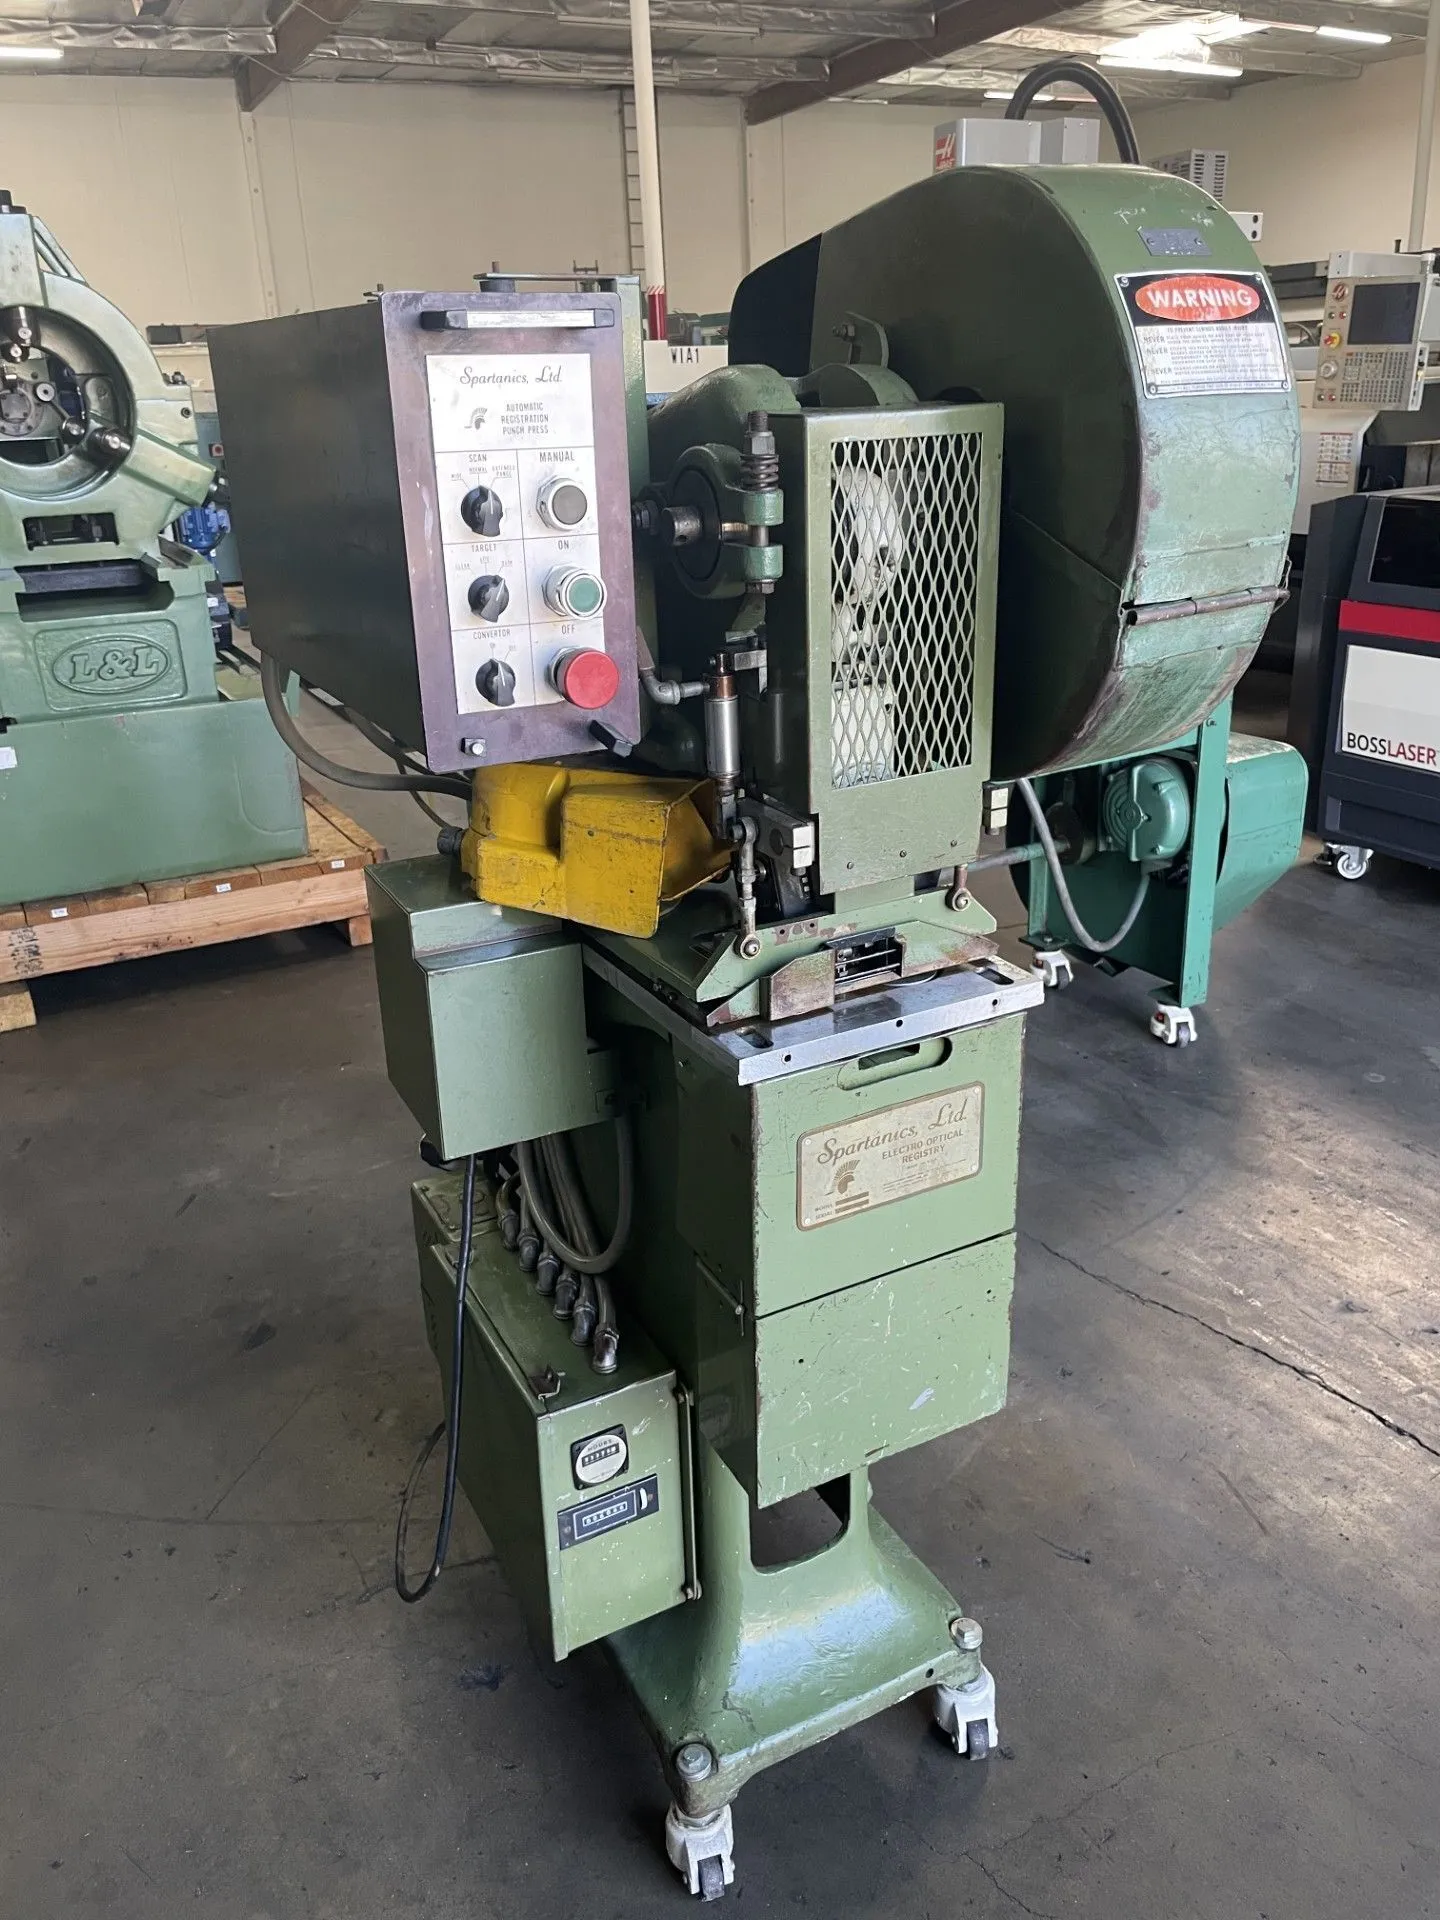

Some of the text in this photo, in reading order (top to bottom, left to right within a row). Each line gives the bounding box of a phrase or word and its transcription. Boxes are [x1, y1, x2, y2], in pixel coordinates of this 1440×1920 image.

[1147, 289, 1253, 308] WARNING
[1143, 335, 1165, 344] NEVER
[506, 402, 544, 411] AUTOMATIC
[500, 415, 549, 424] REGISTRATION
[502, 425, 549, 435] PUNCH PRESS
[468, 453, 488, 462] SCAN
[539, 451, 575, 462] MANUAL
[471, 543, 497, 552] TARGET
[558, 540, 570, 550] ON
[472, 629, 511, 639] CONVERTOR
[561, 626, 576, 635] OFF
[70, 647, 161, 684] L&L
[1346, 732, 1437, 766] BOSSLASER
[881, 1128, 964, 1160] ELECTRO OPTICAL
[902, 1144, 946, 1164] REGISTRY
[587, 1438, 613, 1452] HOURS
